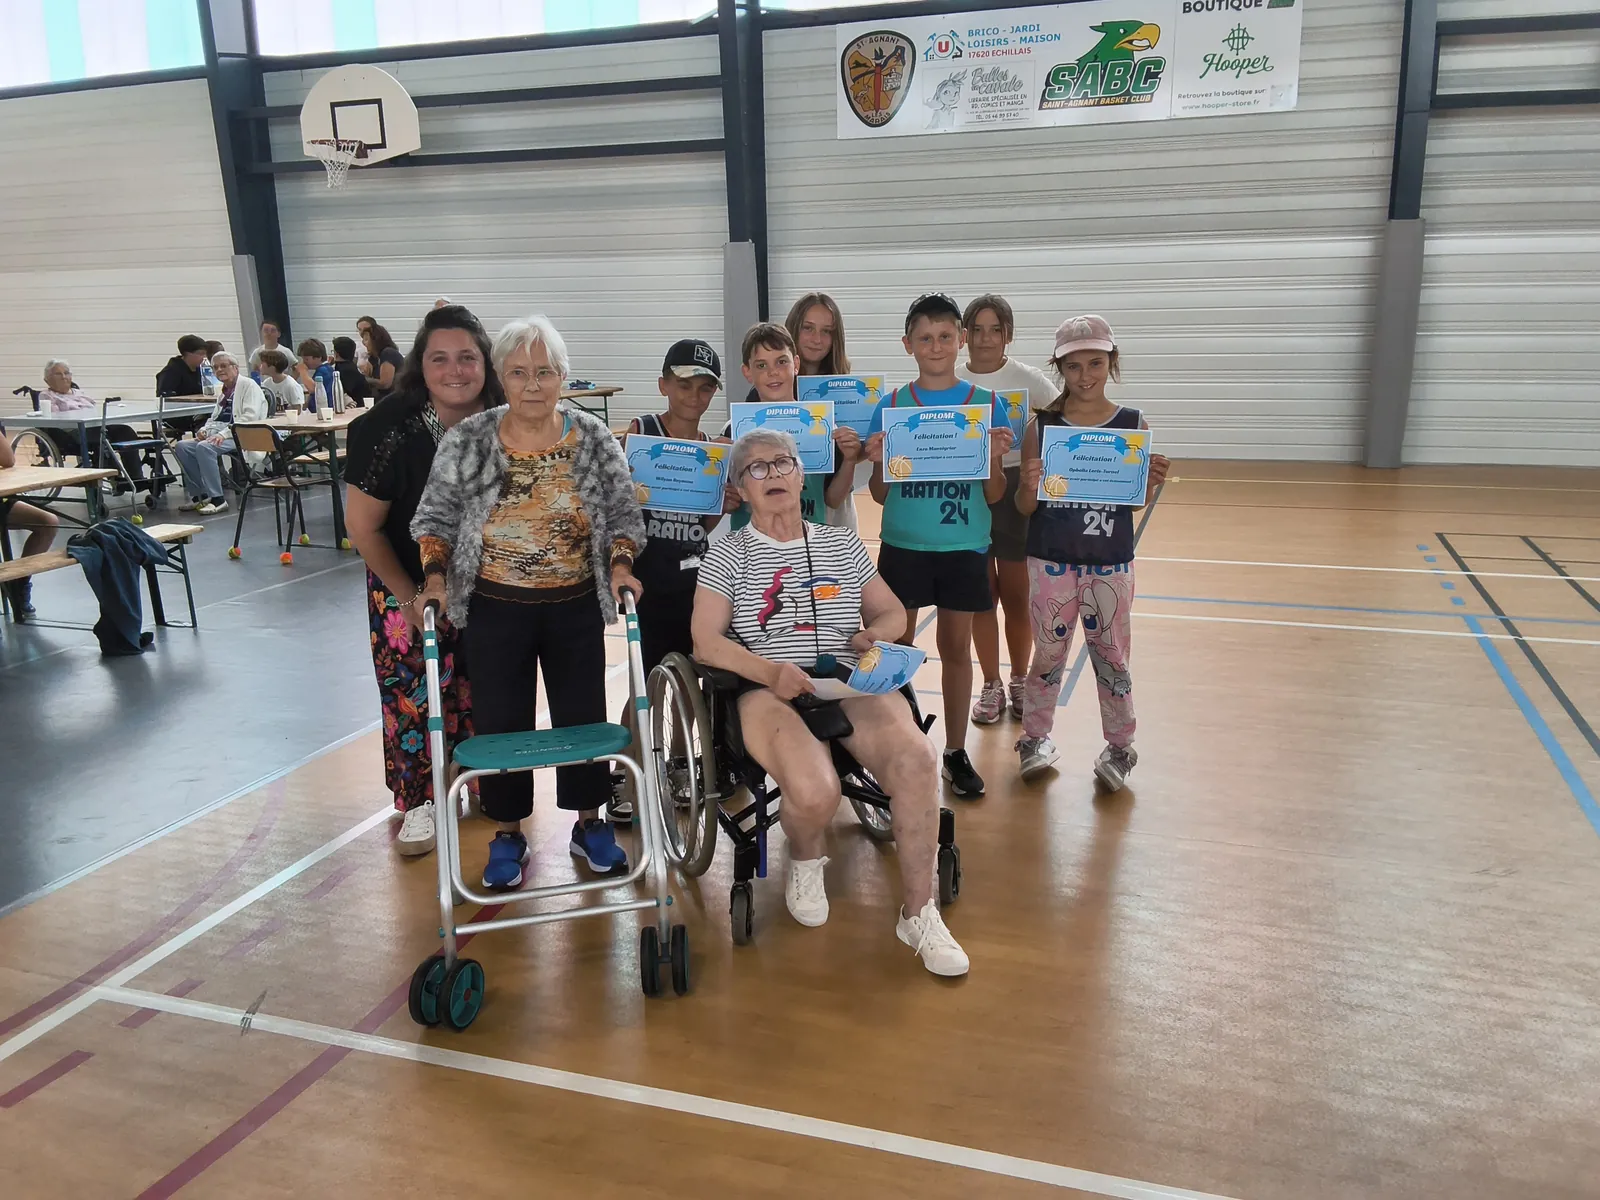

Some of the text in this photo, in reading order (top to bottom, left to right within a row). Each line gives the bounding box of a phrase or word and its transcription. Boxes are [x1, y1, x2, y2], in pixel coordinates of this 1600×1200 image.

[1182, 0, 1263, 13] BOUTIQUE
[968, 27, 999, 37] BRICO
[1010, 23, 1040, 34] JARDI
[968, 37, 1009, 48] LOISIRS
[1020, 33, 1061, 44] MAISON
[968, 46, 1032, 58] 17620 ECHILLAIS
[1199, 53, 1275, 79] Hooper
[1045, 56, 1167, 100] SABC
[1177, 92, 1213, 100] Retrouvez
[1221, 89, 1253, 98] boutique
[1042, 94, 1151, 109] SAINT-AGNANT BASKET CLUB
[827, 380, 857, 388] DIPLOME
[919, 412, 956, 420] DIPLOME
[913, 432, 953, 440] Félicitation
[1080, 433, 1117, 442] DIPLOME
[662, 443, 698, 454] DIPLOME
[1072, 455, 1113, 463] Félicitation
[654, 463, 693, 472] Félicitation
[900, 481, 971, 500] RATION
[939, 500, 969, 526] 24
[1083, 510, 1115, 537] 24
[648, 519, 707, 542] RATIO
